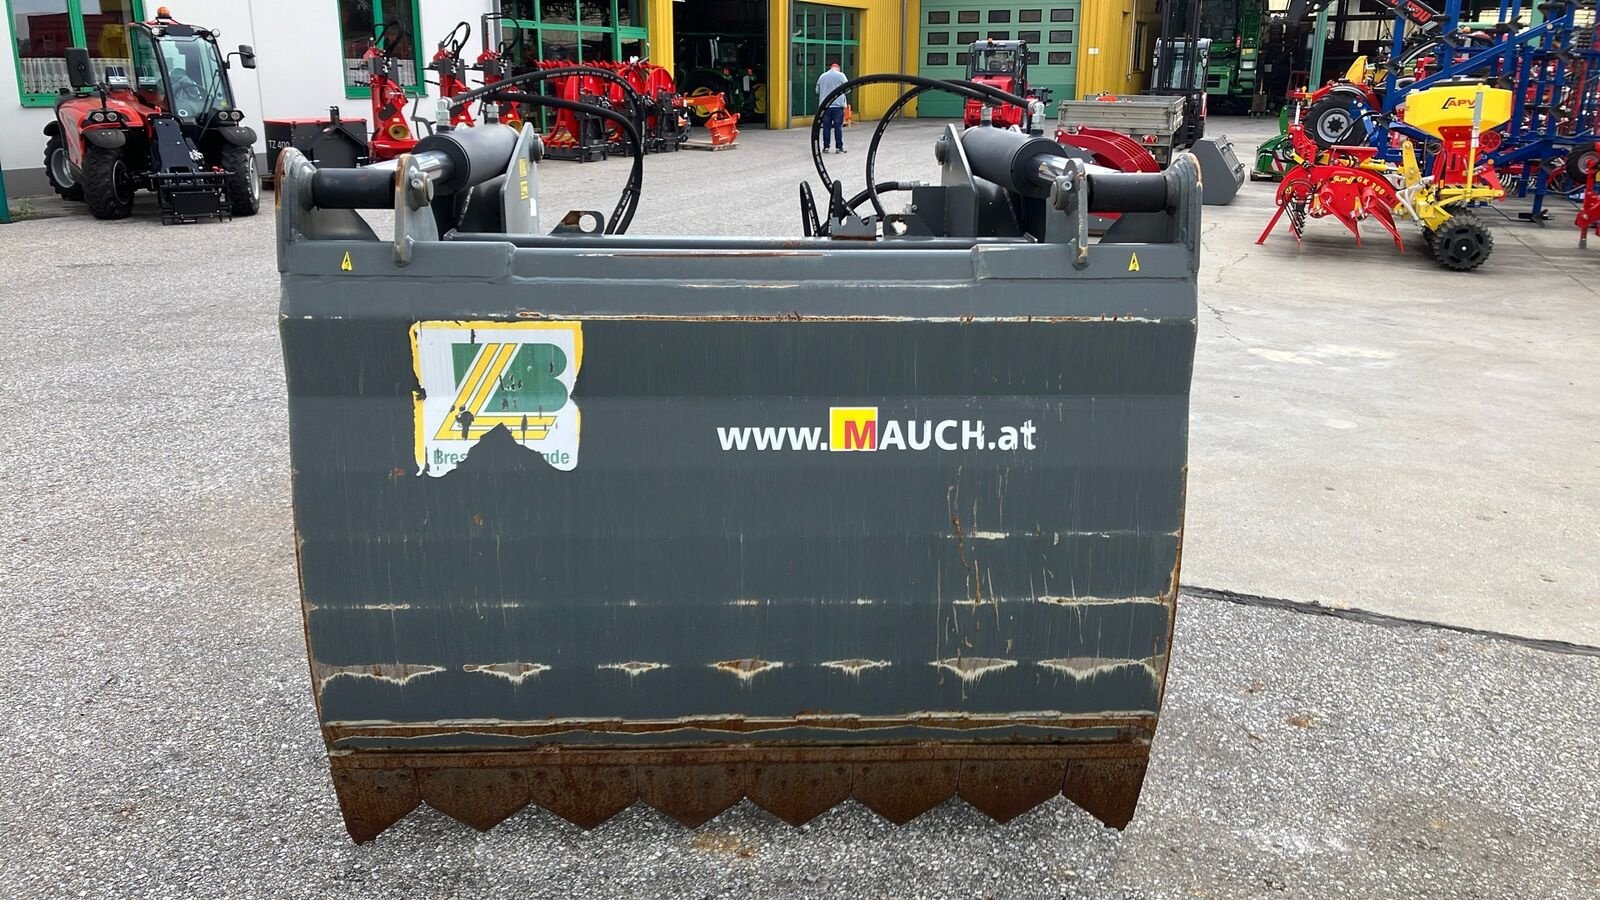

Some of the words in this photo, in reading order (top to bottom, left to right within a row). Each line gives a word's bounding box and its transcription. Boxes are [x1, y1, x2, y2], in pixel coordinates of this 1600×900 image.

[1445, 98, 1476, 108] APV
[267, 139, 277, 149] TZ
[277, 141, 290, 149] 400
[1356, 176, 1370, 185] GK
[1370, 182, 1385, 195] 300
[717, 419, 1037, 452] www.MAUCH.at
[433, 449, 468, 465] Bres
